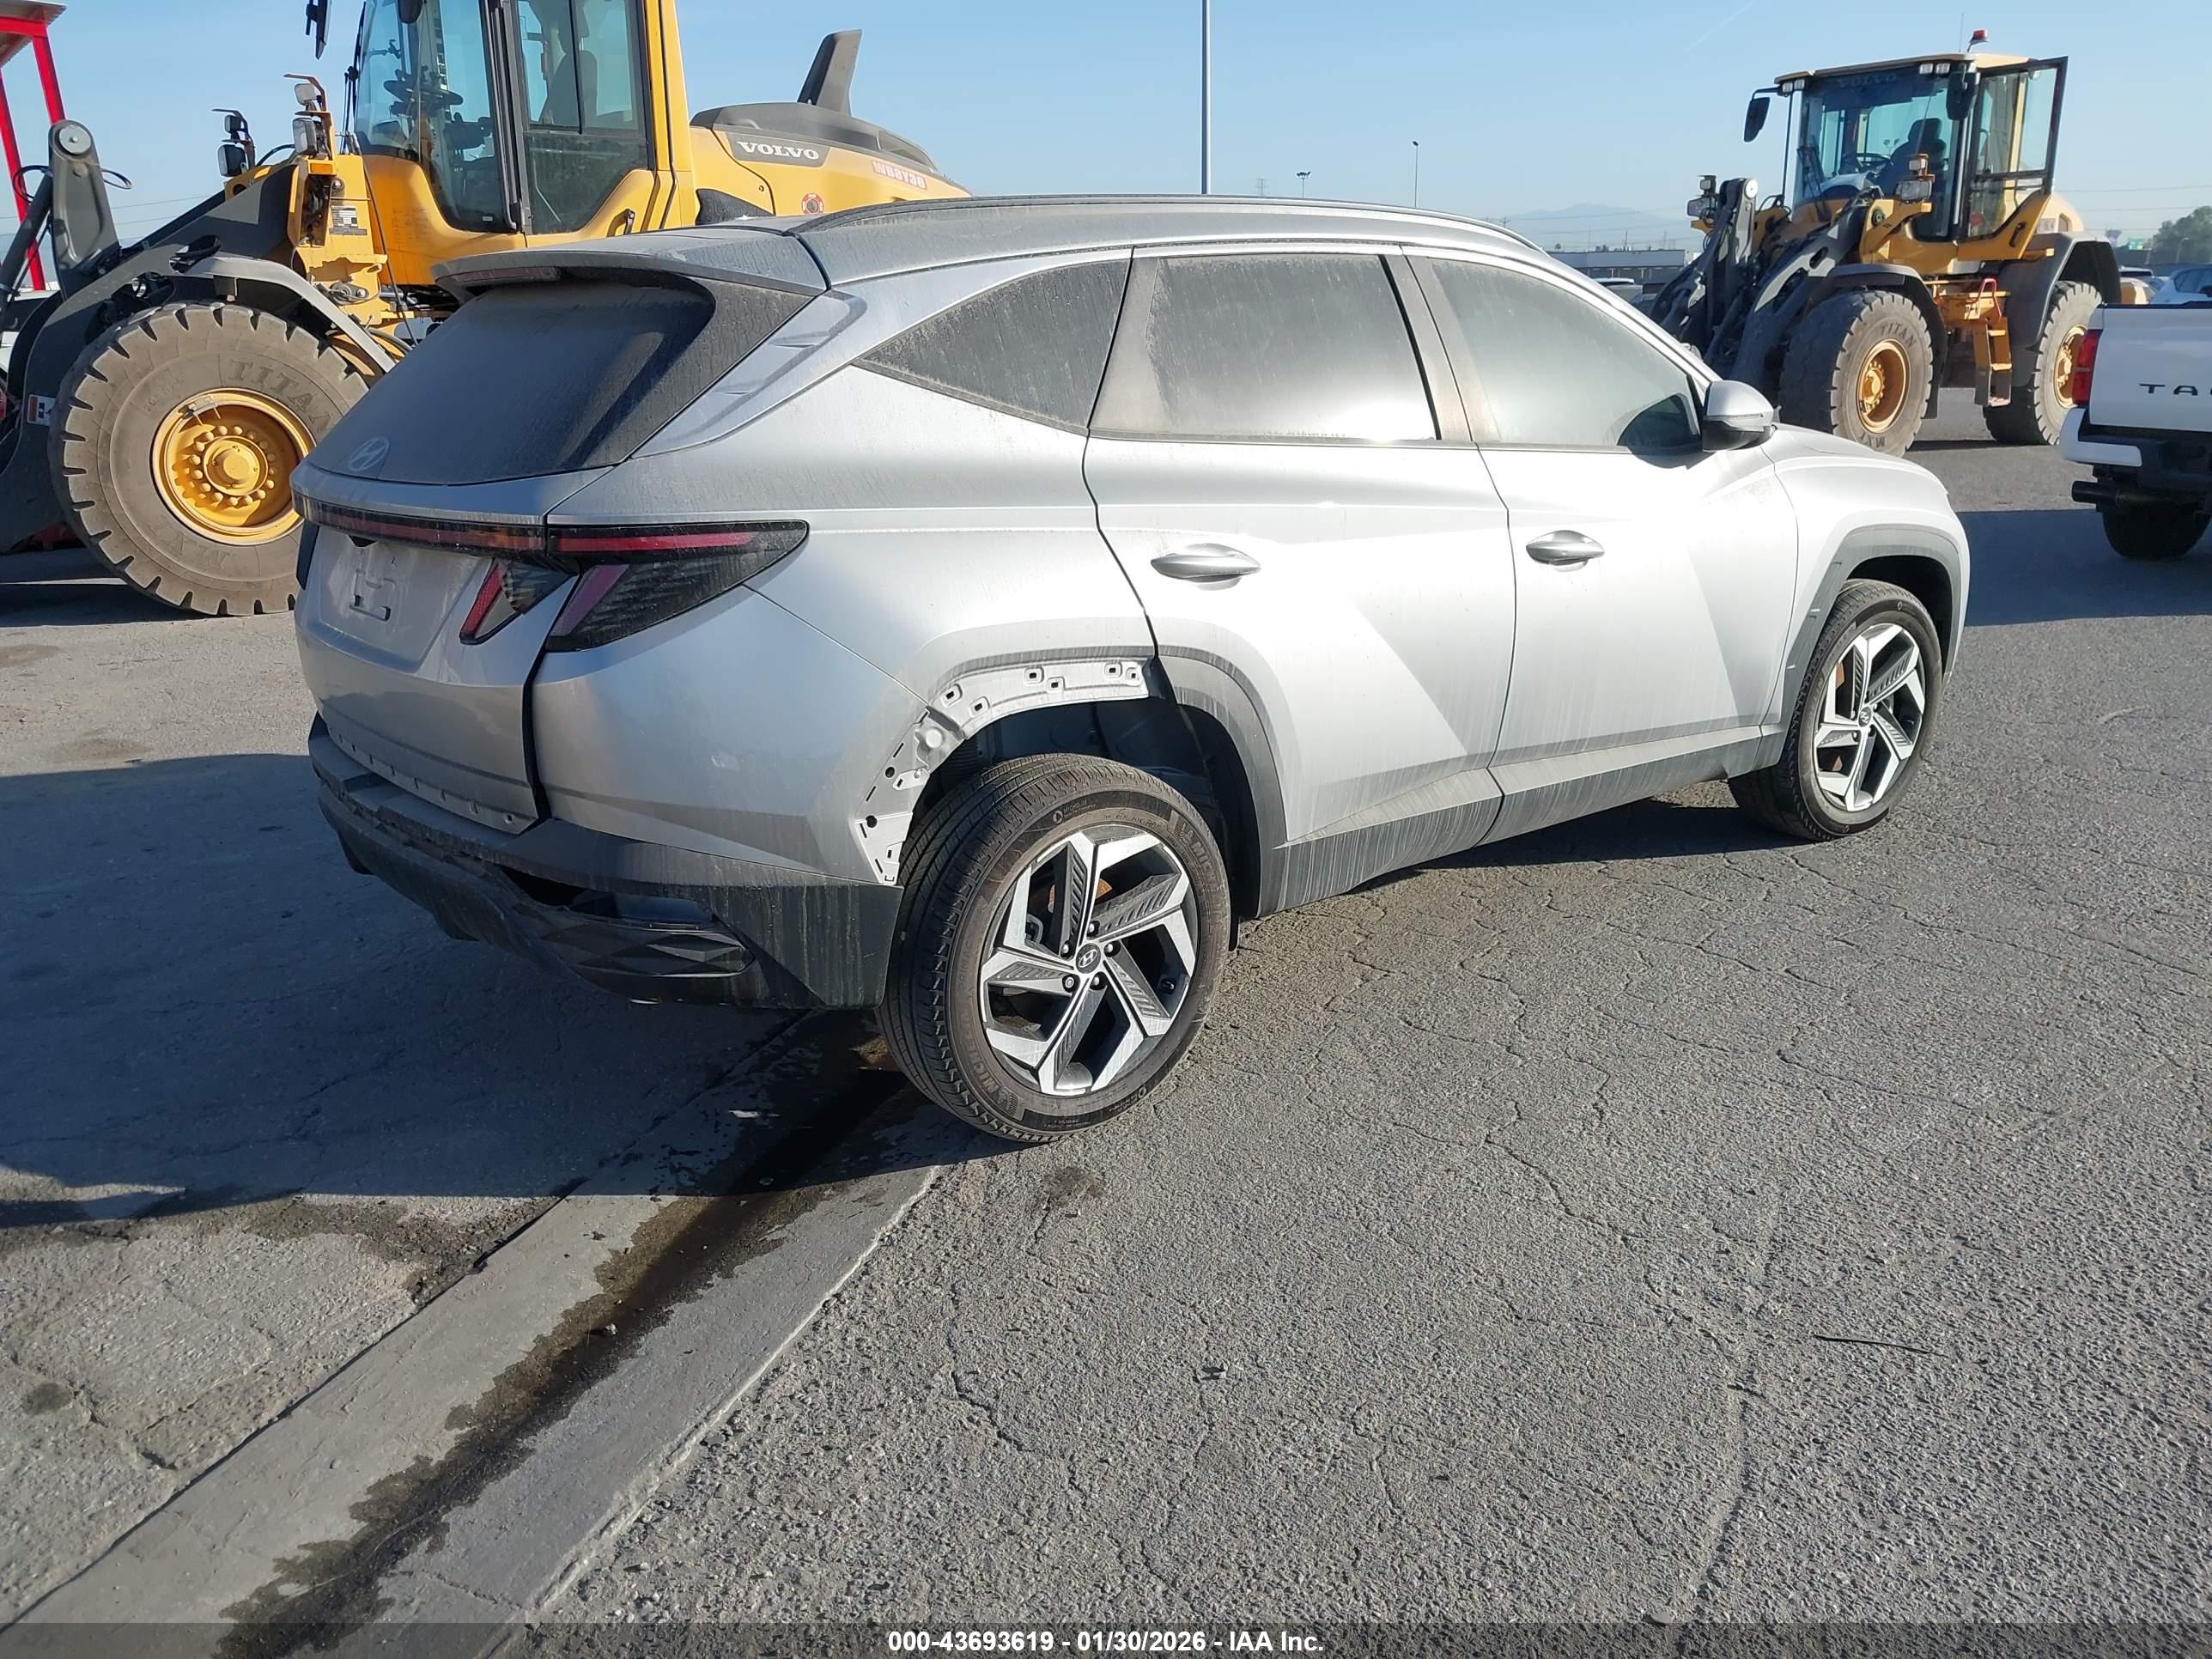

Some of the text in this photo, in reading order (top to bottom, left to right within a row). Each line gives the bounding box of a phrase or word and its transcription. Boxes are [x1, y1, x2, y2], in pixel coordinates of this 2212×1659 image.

[737, 141, 819, 160] VOLVO
[1881, 321, 1917, 348] TITAN
[2139, 383, 2212, 396] TA
